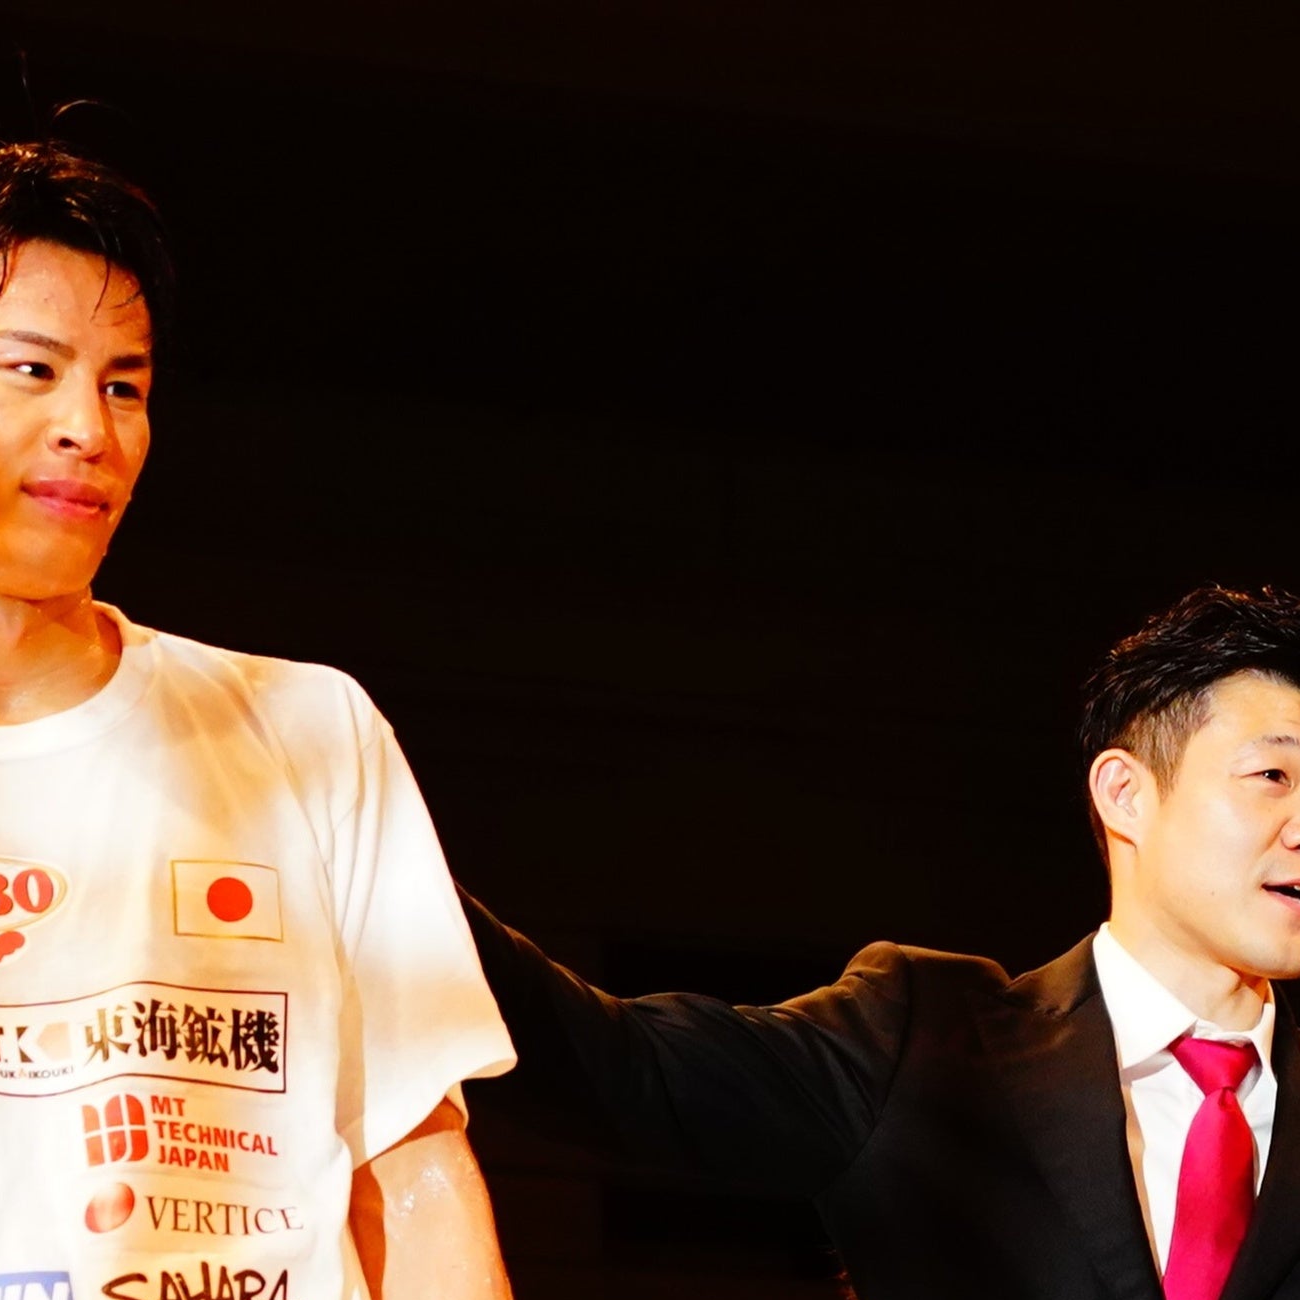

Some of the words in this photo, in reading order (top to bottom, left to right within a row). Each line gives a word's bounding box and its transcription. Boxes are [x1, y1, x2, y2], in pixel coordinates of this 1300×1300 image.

[84, 998, 280, 1074] 東海鉱機
[151, 1095, 185, 1117] MT
[153, 1120, 278, 1156] TECHNICAL
[158, 1145, 230, 1172] JAPAN
[145, 1196, 304, 1236] VERTICE
